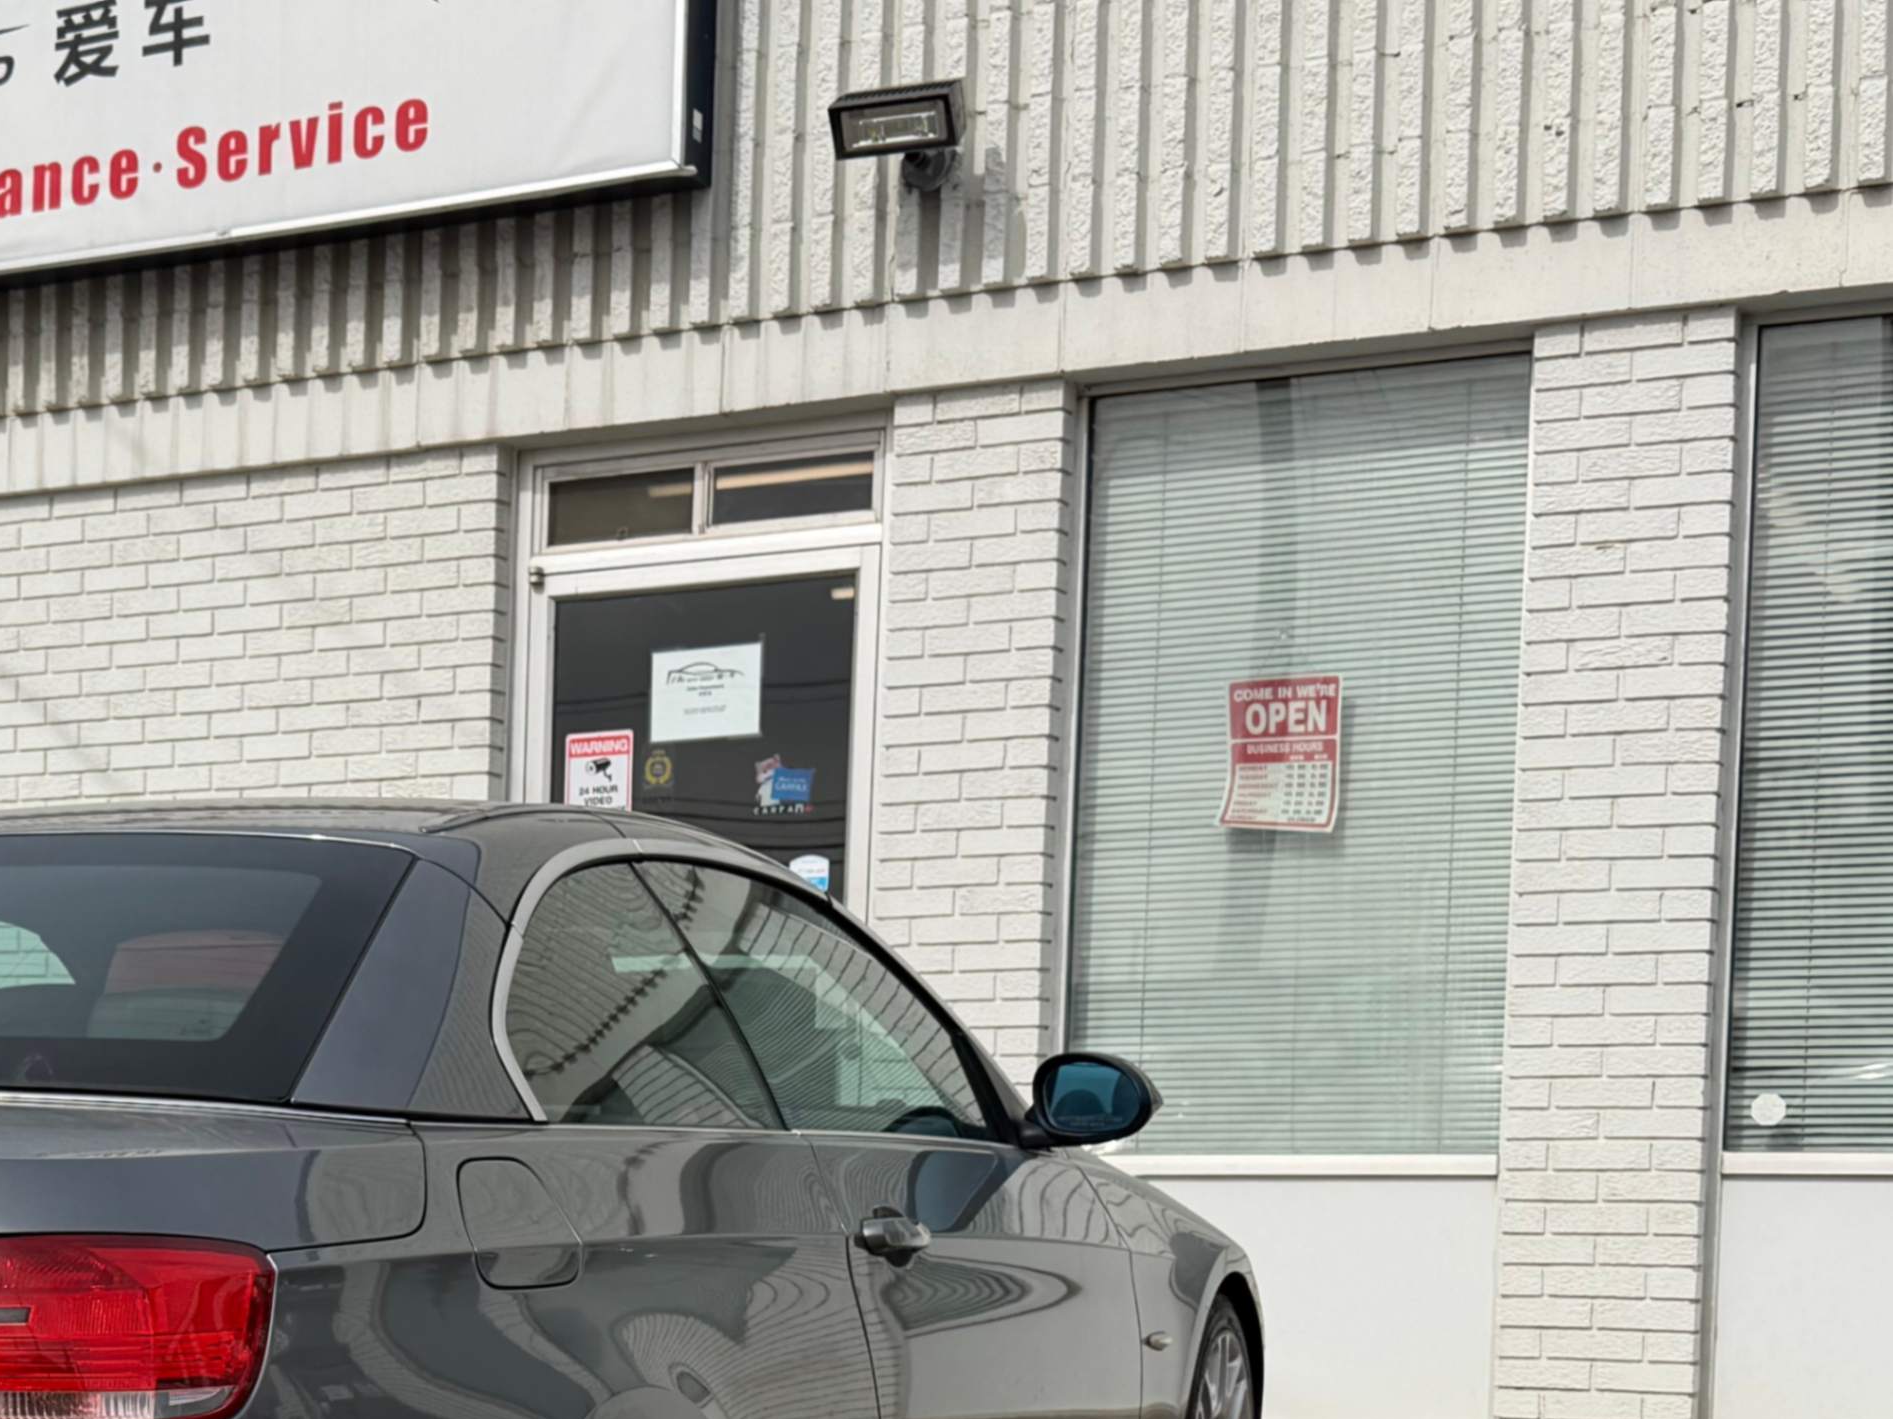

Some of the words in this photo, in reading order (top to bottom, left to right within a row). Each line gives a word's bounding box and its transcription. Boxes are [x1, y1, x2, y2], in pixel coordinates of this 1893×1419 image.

[54, 0, 210, 86] 爱车
[1234, 688, 1274, 702] COME
[1278, 686, 1293, 699] IN
[1296, 684, 1337, 699] WE'RE
[1245, 700, 1327, 736] OPEN
[570, 738, 629, 755] WARNING
[1247, 743, 1290, 755] BUSINESS
[1292, 741, 1324, 753] HOURS
[579, 786, 590, 796] 24
[592, 784, 619, 794] HOUR
[584, 796, 613, 807] VIDEO
